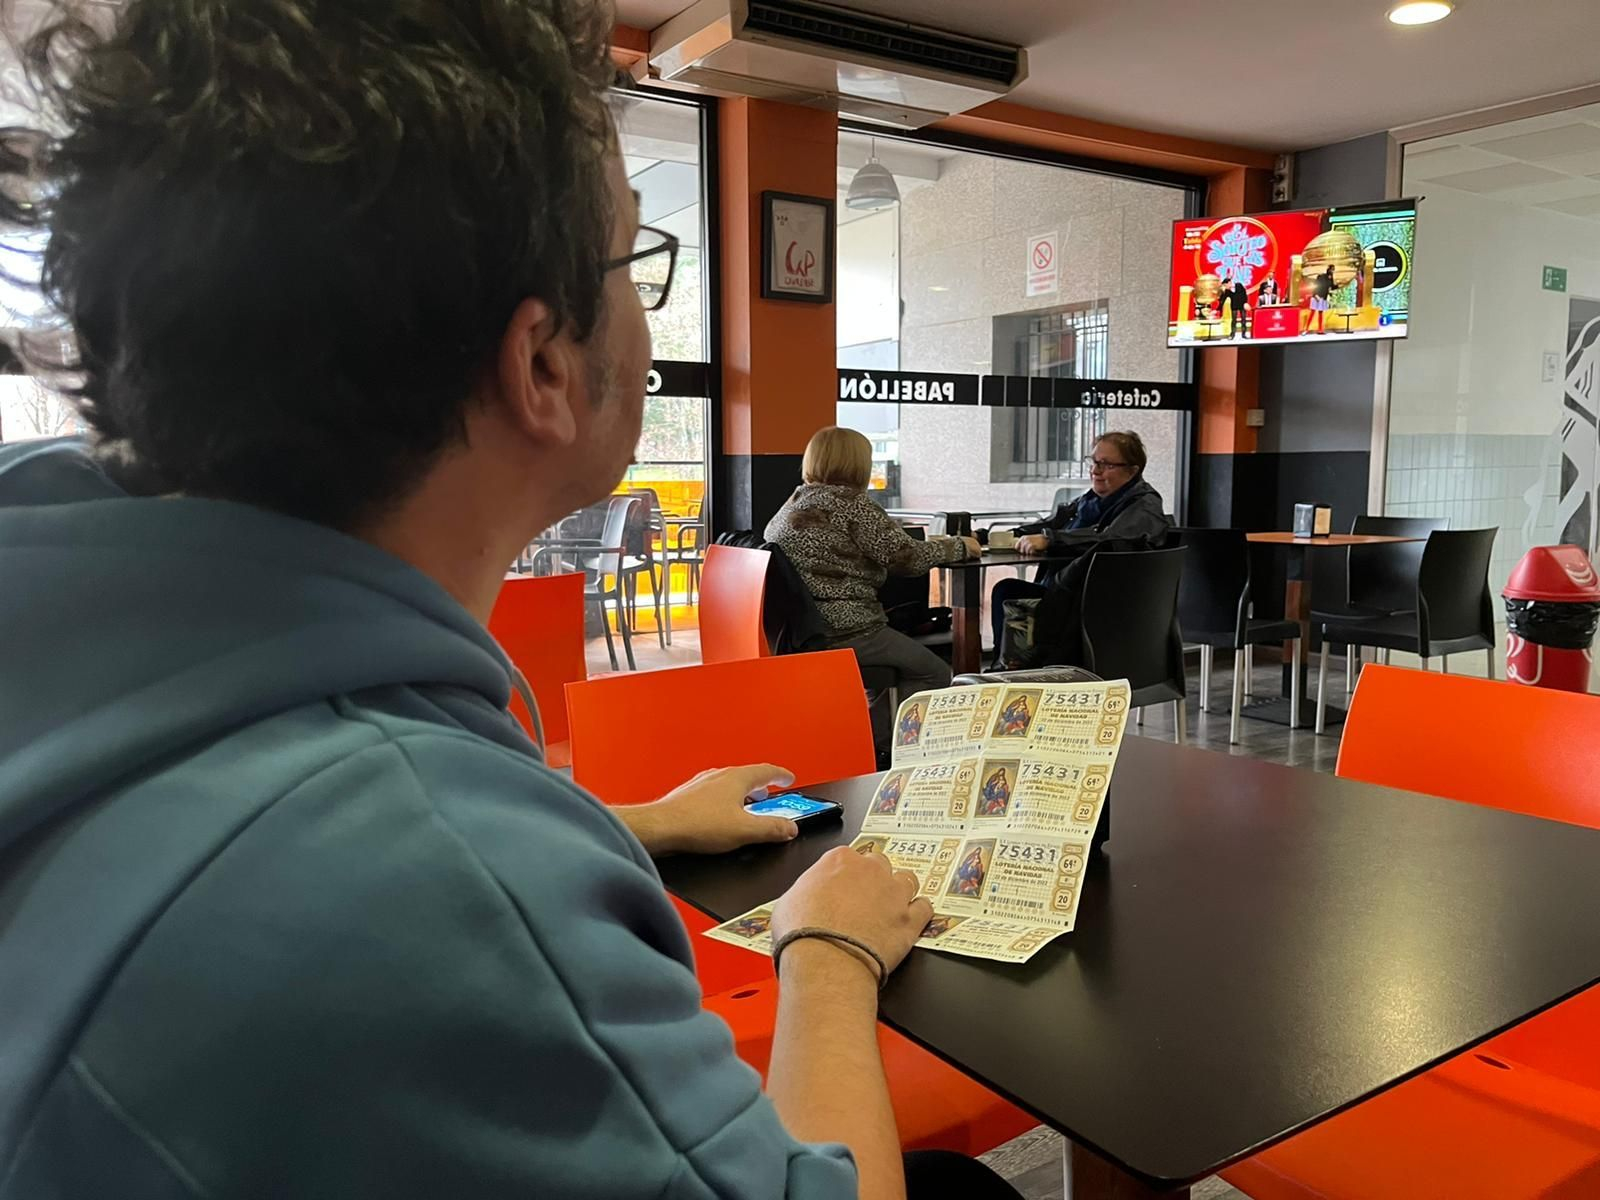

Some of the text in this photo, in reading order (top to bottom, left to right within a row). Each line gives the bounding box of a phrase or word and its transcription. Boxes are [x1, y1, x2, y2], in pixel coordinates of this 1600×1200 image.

[931, 693, 976, 708] 75431
[1045, 693, 1101, 705] 75431
[972, 725, 982, 733] 20
[914, 766, 956, 779] 75431
[1022, 764, 1080, 780] 75431
[954, 802, 964, 810] 20
[1079, 808, 1090, 816] 20
[888, 841, 936, 855] 75431
[999, 844, 1056, 862] 75431
[995, 861, 1055, 873] LOTERÍA NACIONAL
[1014, 870, 1043, 878] NAVIDAD
[929, 880, 938, 889] 20
[1057, 894, 1069, 904] 20
